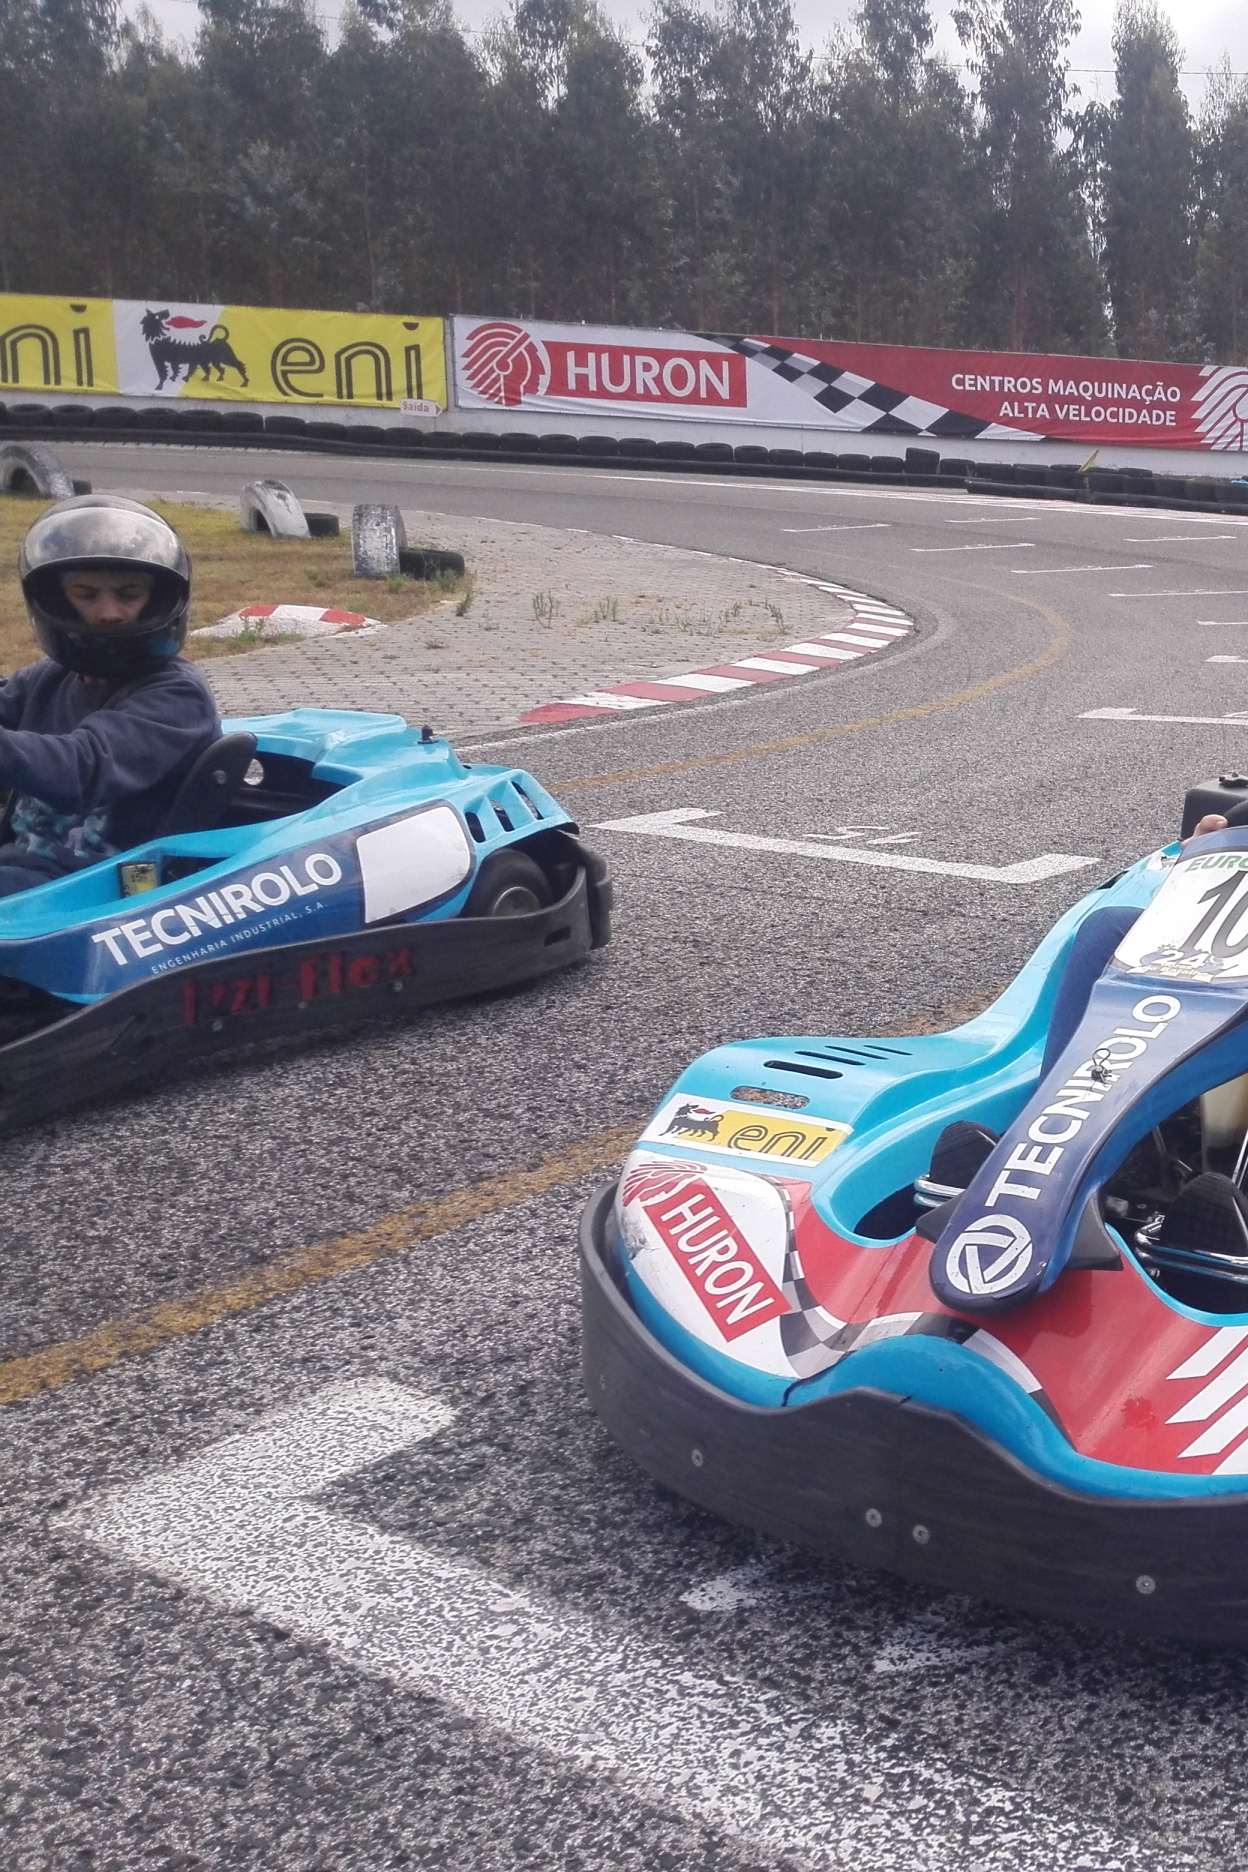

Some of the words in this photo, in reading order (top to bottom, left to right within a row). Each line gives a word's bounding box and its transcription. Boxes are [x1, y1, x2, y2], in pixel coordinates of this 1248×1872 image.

[271, 322, 424, 401] eni
[566, 350, 730, 400] HURON
[951, 373, 1043, 394] CENTROS
[1048, 379, 1182, 405] MAQUINAÇÃO
[999, 402, 1050, 419] ALTA
[1055, 404, 1177, 426] VELOCIDADE
[91, 853, 343, 966] TECNIROLO
[151, 939, 228, 975] ENGENHARIA
[984, 995, 1181, 1207] TECNIROLO
[727, 1124, 836, 1161] eni
[660, 1193, 775, 1325] HURON
